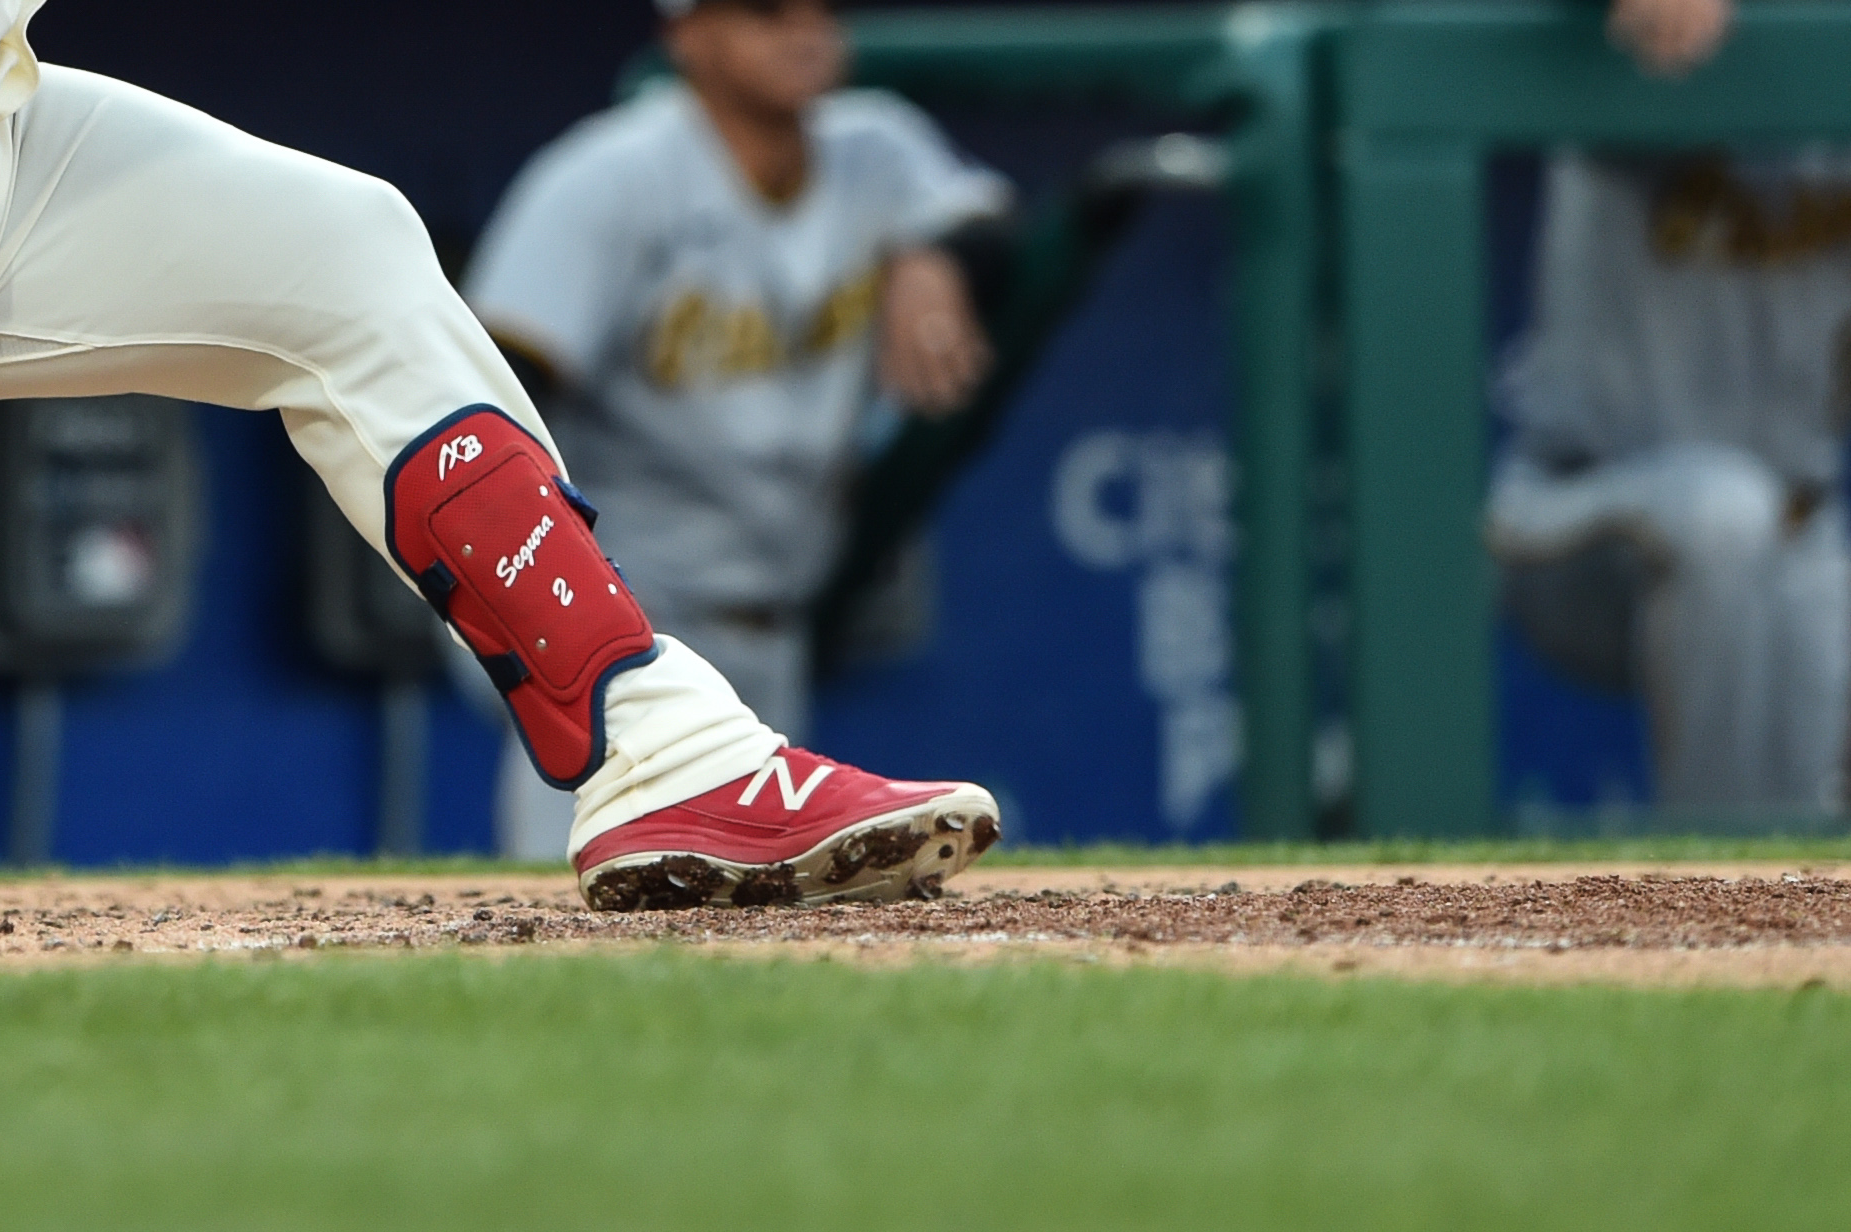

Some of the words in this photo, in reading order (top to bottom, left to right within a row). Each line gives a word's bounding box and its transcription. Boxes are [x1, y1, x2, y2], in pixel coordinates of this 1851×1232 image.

[496, 515, 555, 588] Segura
[552, 577, 574, 607] 2
[737, 755, 836, 811] N
